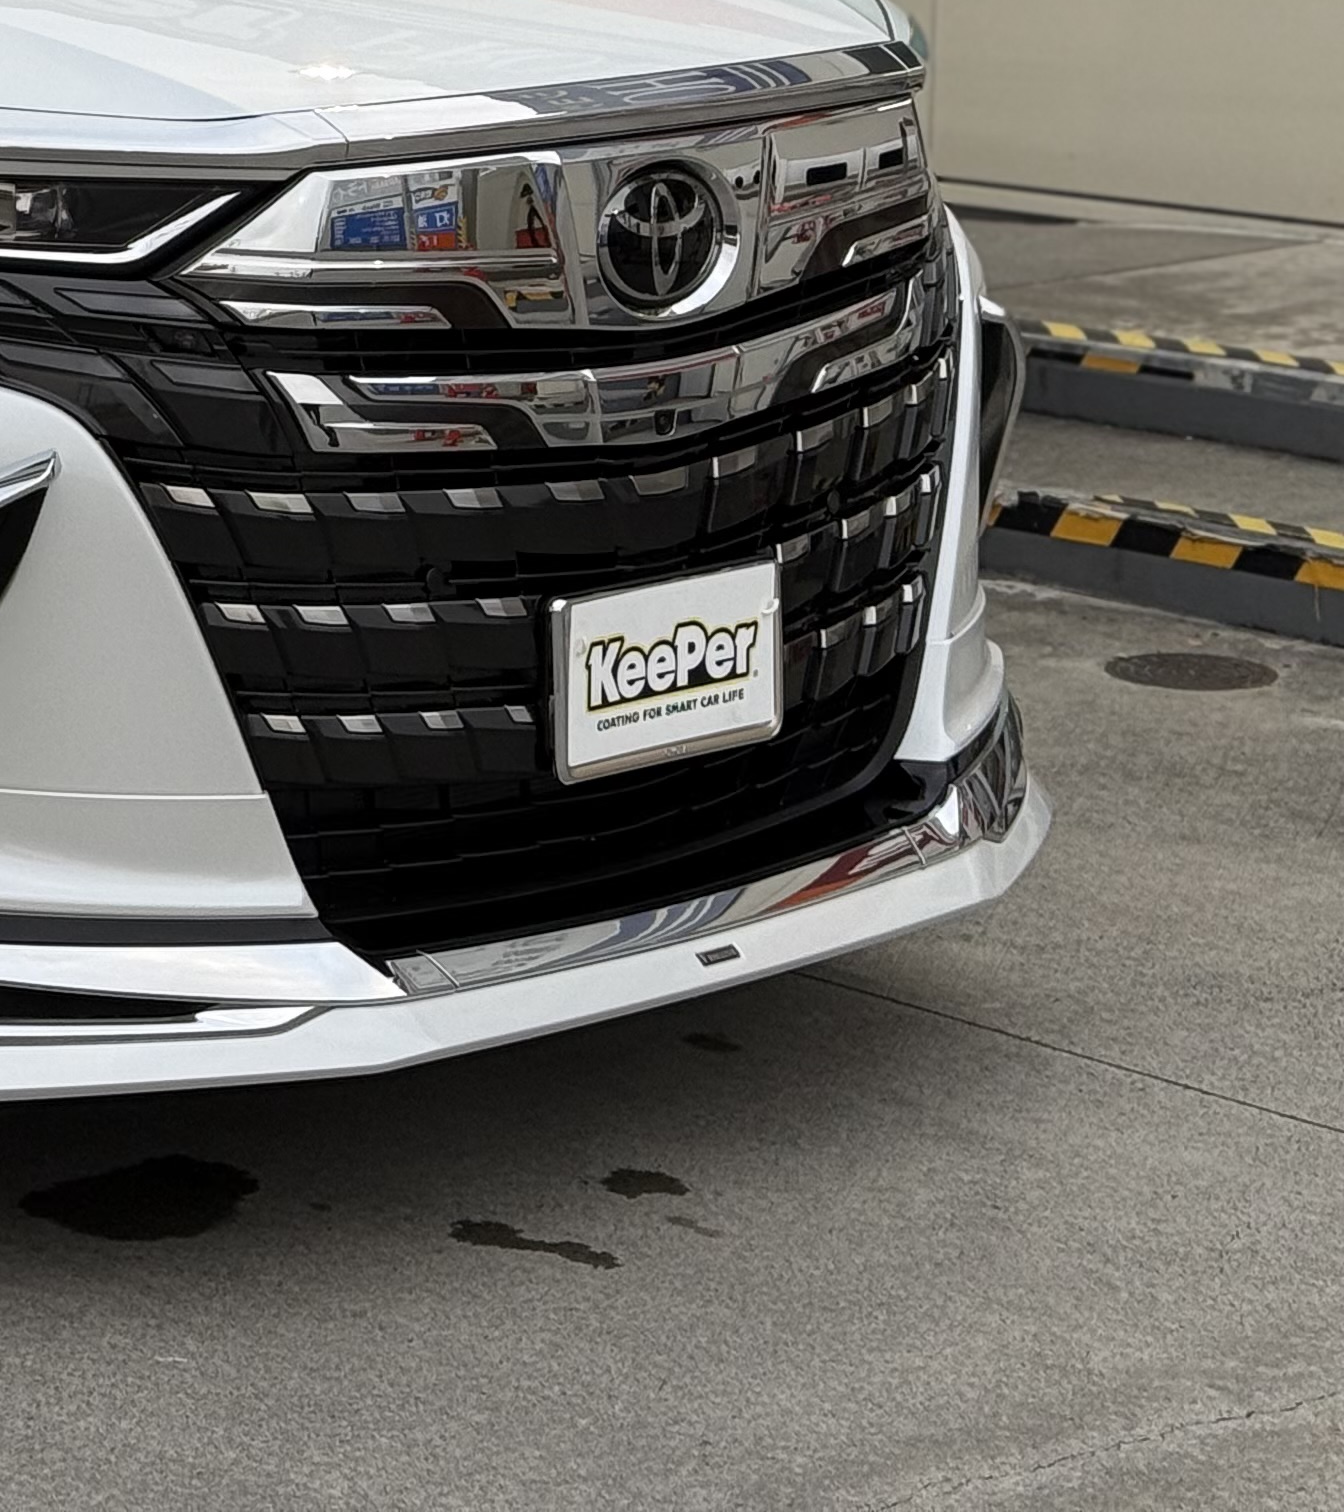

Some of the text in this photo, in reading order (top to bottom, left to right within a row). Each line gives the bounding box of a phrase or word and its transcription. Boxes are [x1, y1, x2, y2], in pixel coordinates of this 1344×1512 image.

[586, 620, 758, 711] KeePer
[597, 688, 745, 732] COATING FOR SMART CAR LIFE
